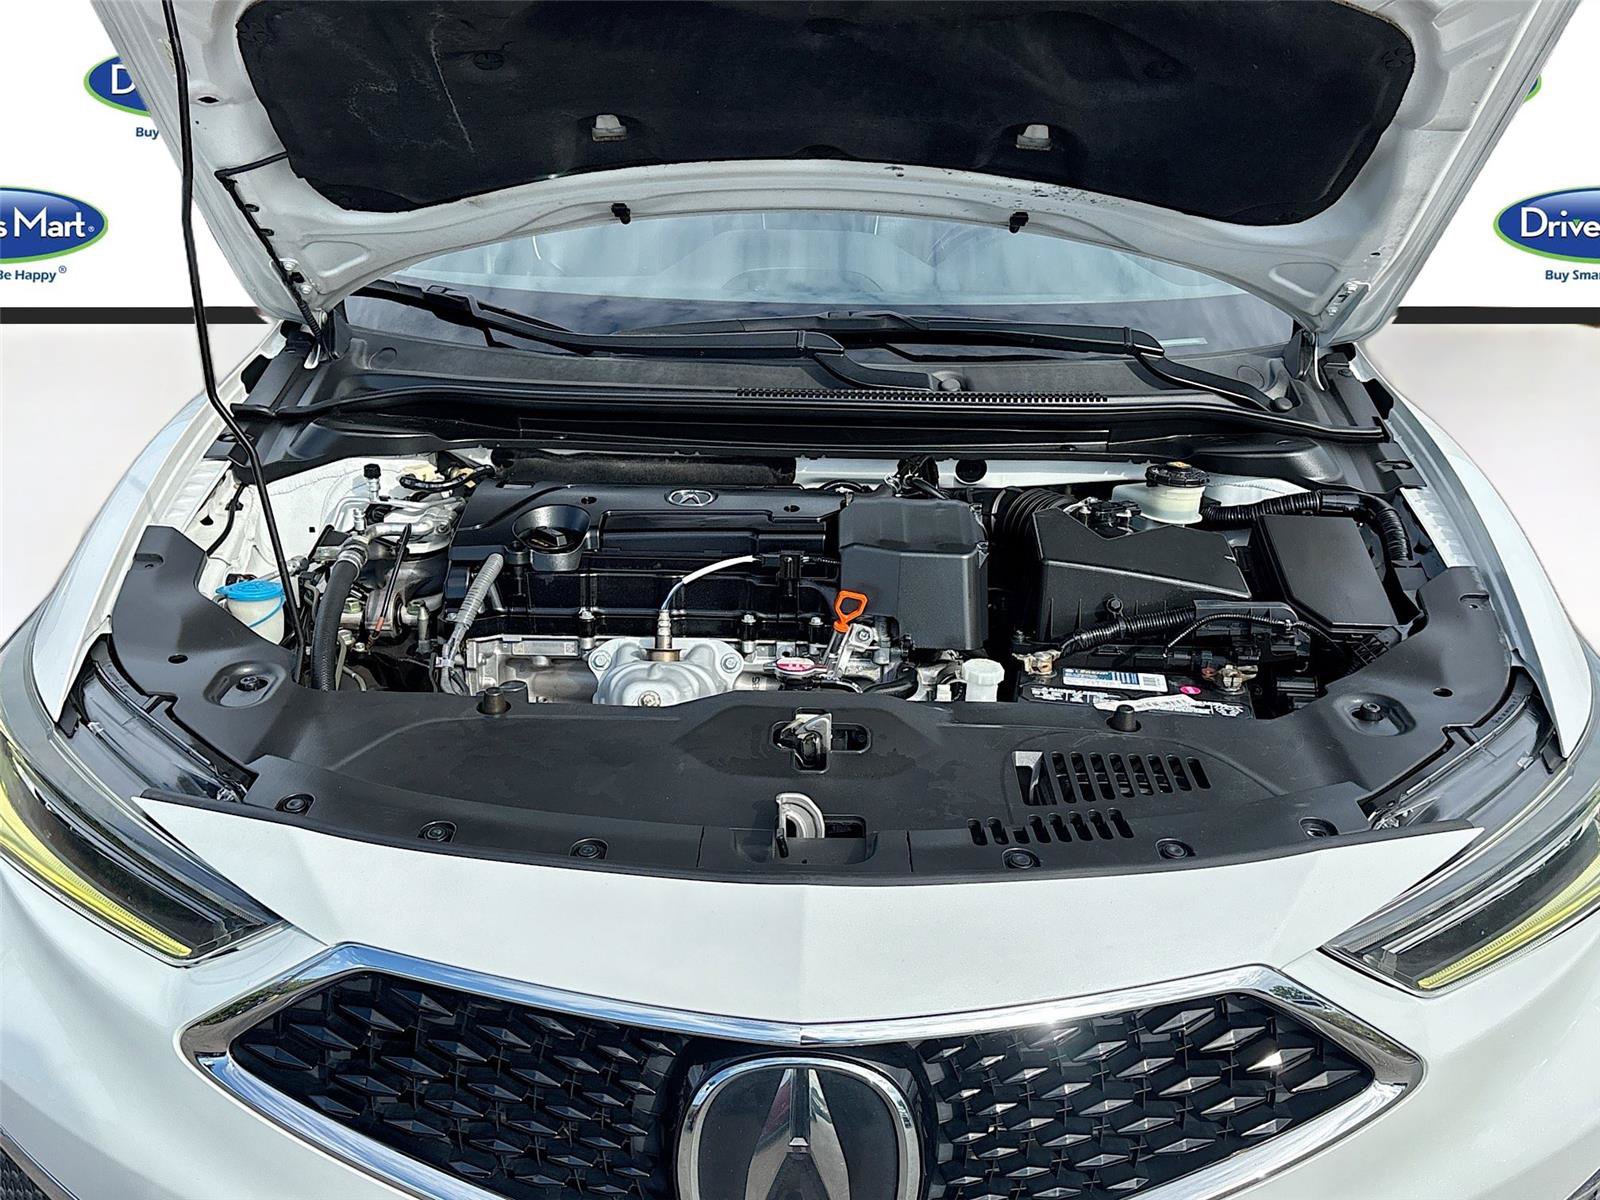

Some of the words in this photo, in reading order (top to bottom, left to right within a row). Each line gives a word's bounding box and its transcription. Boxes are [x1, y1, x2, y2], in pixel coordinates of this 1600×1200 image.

[135, 126, 160, 141] Buy
[13, 206, 86, 238] Mart
[1521, 206, 1600, 238] Drive
[14, 269, 57, 283] Happy
[1545, 269, 1570, 283] Buy
[1572, 269, 1600, 281] Sma
